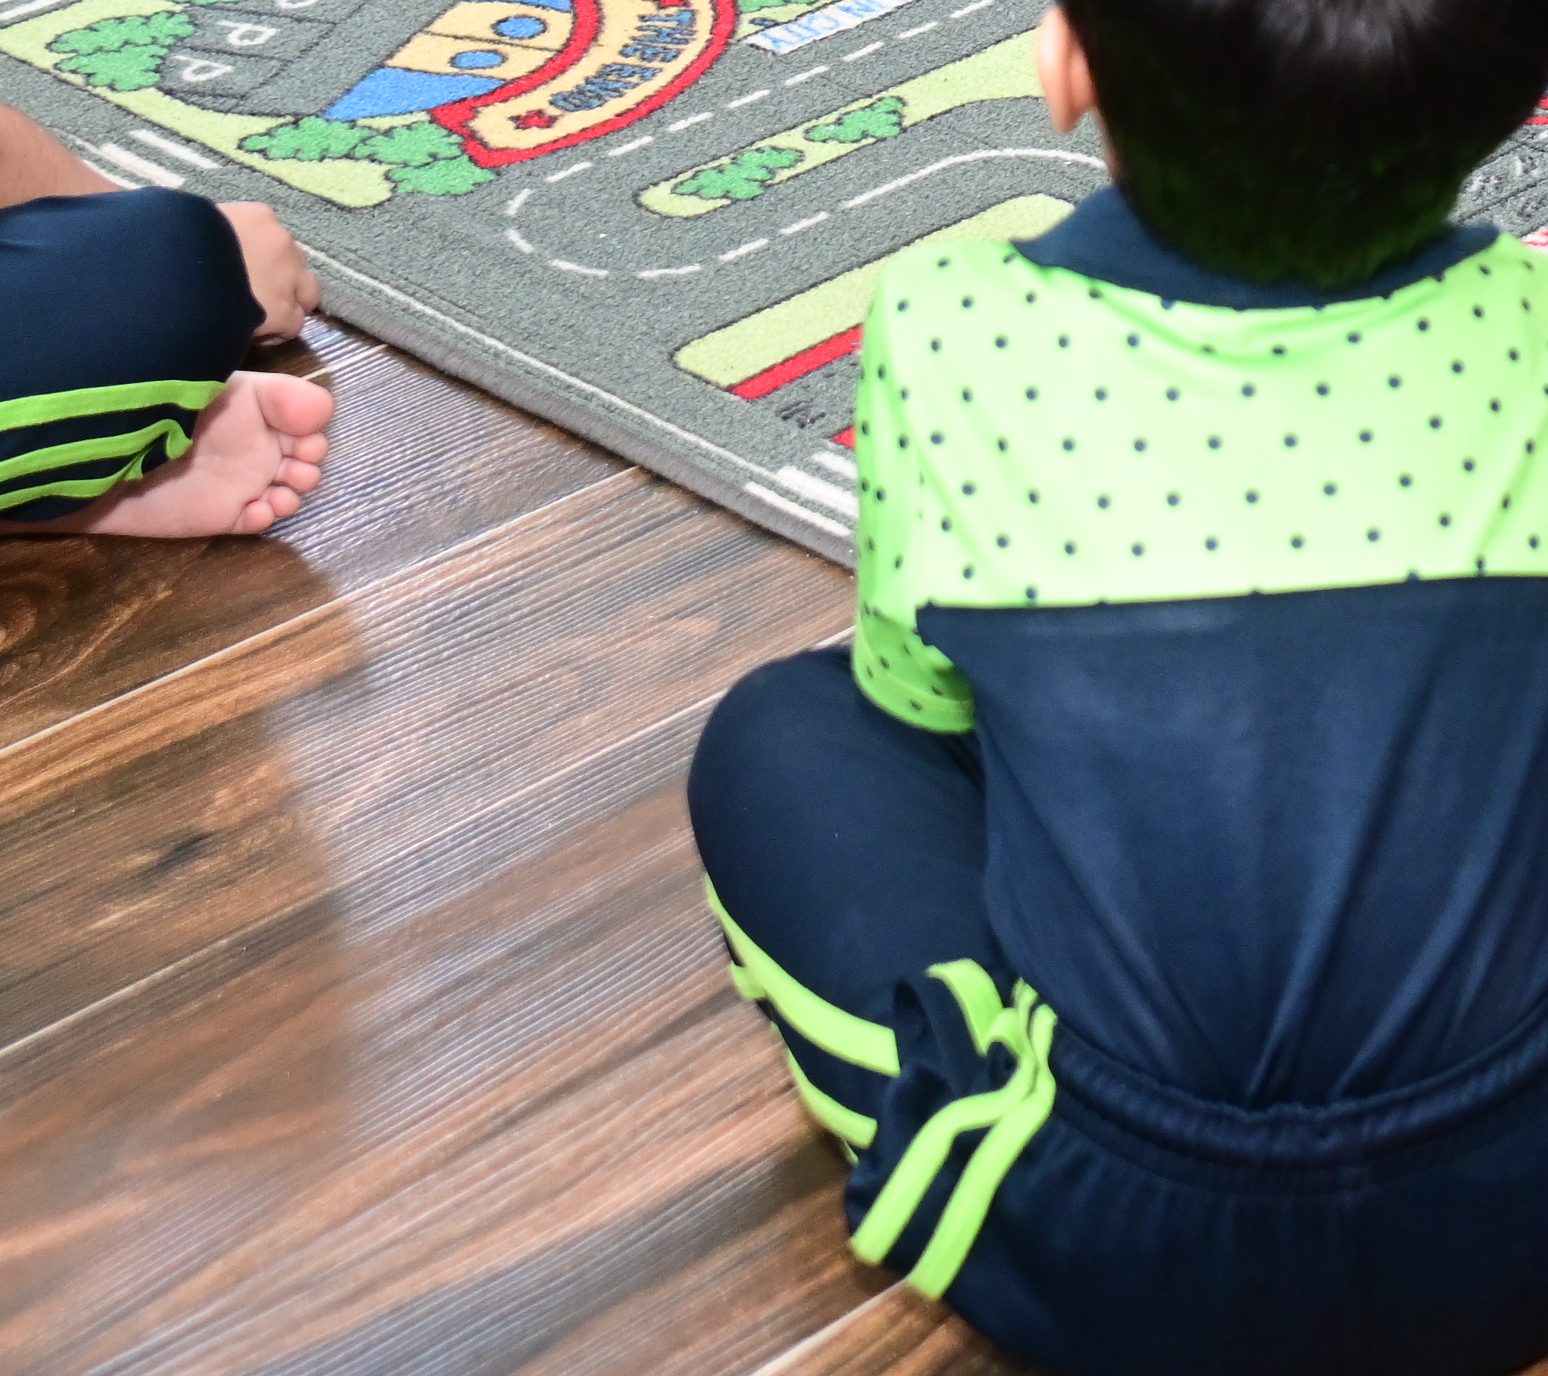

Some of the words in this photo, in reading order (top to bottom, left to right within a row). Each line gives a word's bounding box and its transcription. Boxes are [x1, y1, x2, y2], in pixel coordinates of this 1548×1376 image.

[215, 19, 280, 47] P
[617, 8, 698, 64] THE
[170, 54, 236, 83] P
[547, 61, 665, 113] END
